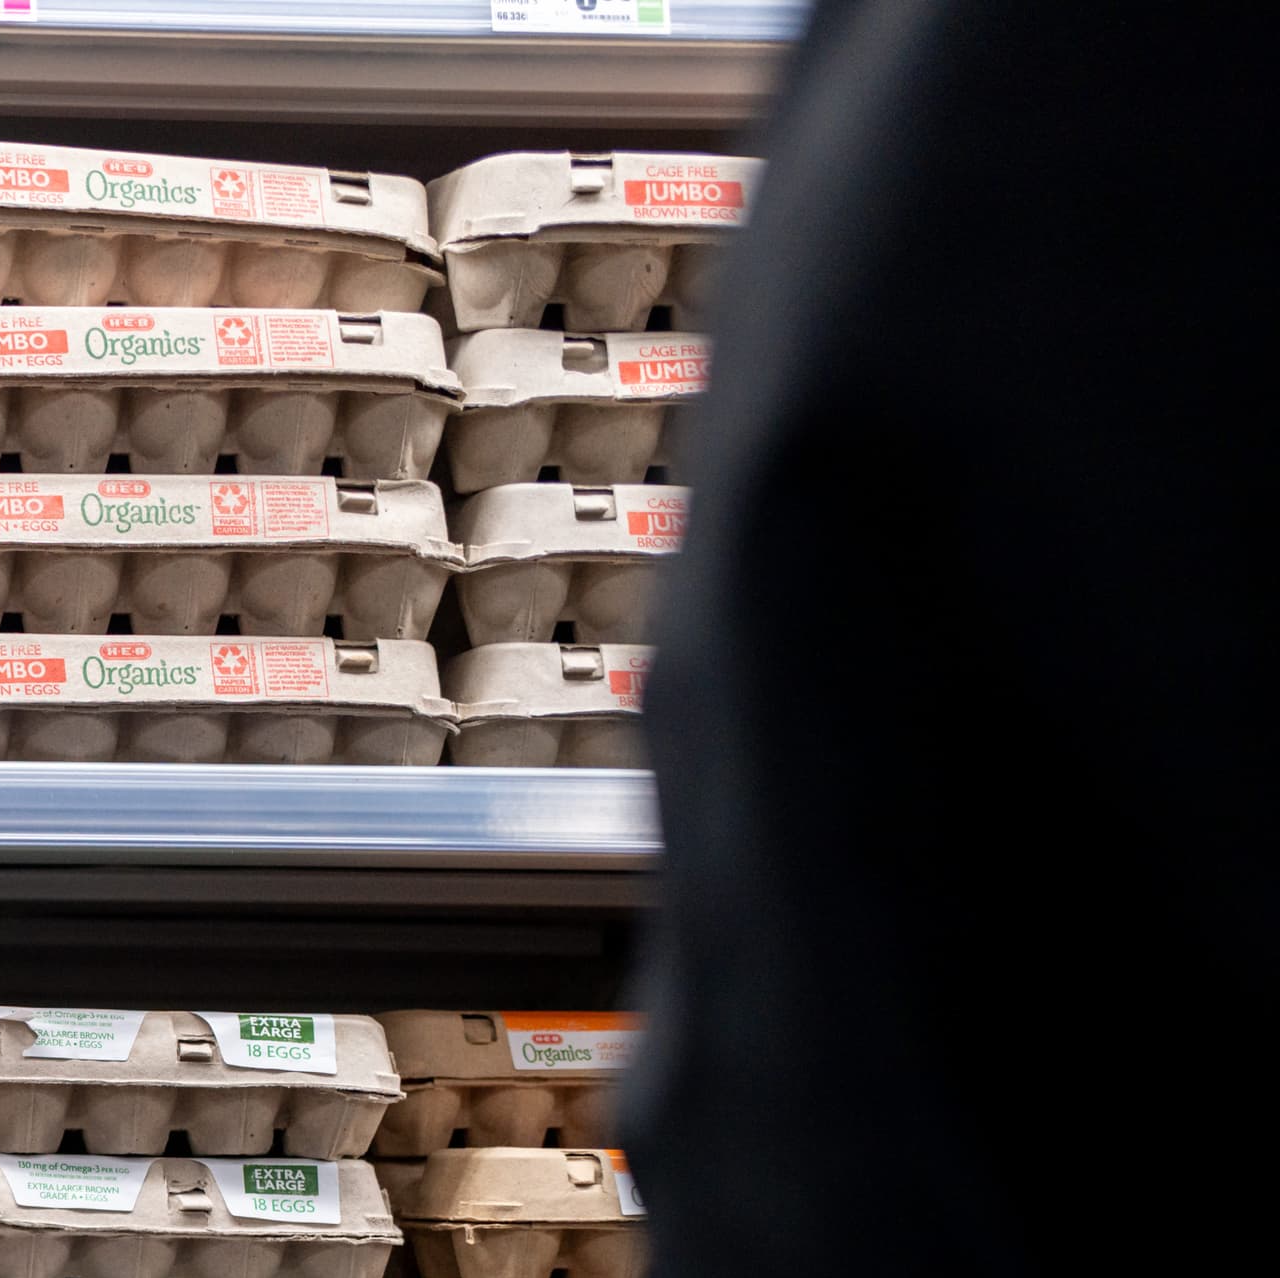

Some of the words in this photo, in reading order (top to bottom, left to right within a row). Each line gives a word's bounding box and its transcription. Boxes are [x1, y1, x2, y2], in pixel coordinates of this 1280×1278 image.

[15, 153, 45, 166] FREE
[646, 165, 683, 178] CAGE
[687, 166, 718, 178] FREE
[85, 170, 197, 208] Organics
[645, 183, 721, 203] JUMBO
[27, 192, 64, 204] EGGS
[634, 207, 687, 219] BROWN
[700, 208, 737, 219] EGGS
[12, 316, 43, 328] FREE
[84, 327, 200, 365] Organics
[640, 346, 676, 358] CAGE
[26, 355, 63, 367] EGGS
[8, 482, 39, 494] FREE
[81, 493, 196, 534] Organics
[21, 520, 58, 532] EGGS
[11, 644, 42, 655] FREE
[82, 655, 197, 694] Organics
[25, 684, 61, 695] EGGS
[249, 1016, 300, 1028] EXTRA
[251, 1027, 301, 1039] LARGE
[246, 1044, 261, 1058] 18
[265, 1044, 311, 1060] EGGS
[522, 1043, 592, 1066] Organics
[253, 1168, 306, 1181] EXTRA
[255, 1179, 306, 1192] LARGE
[251, 1197, 266, 1211] 18
[271, 1198, 315, 1213] EGGS
